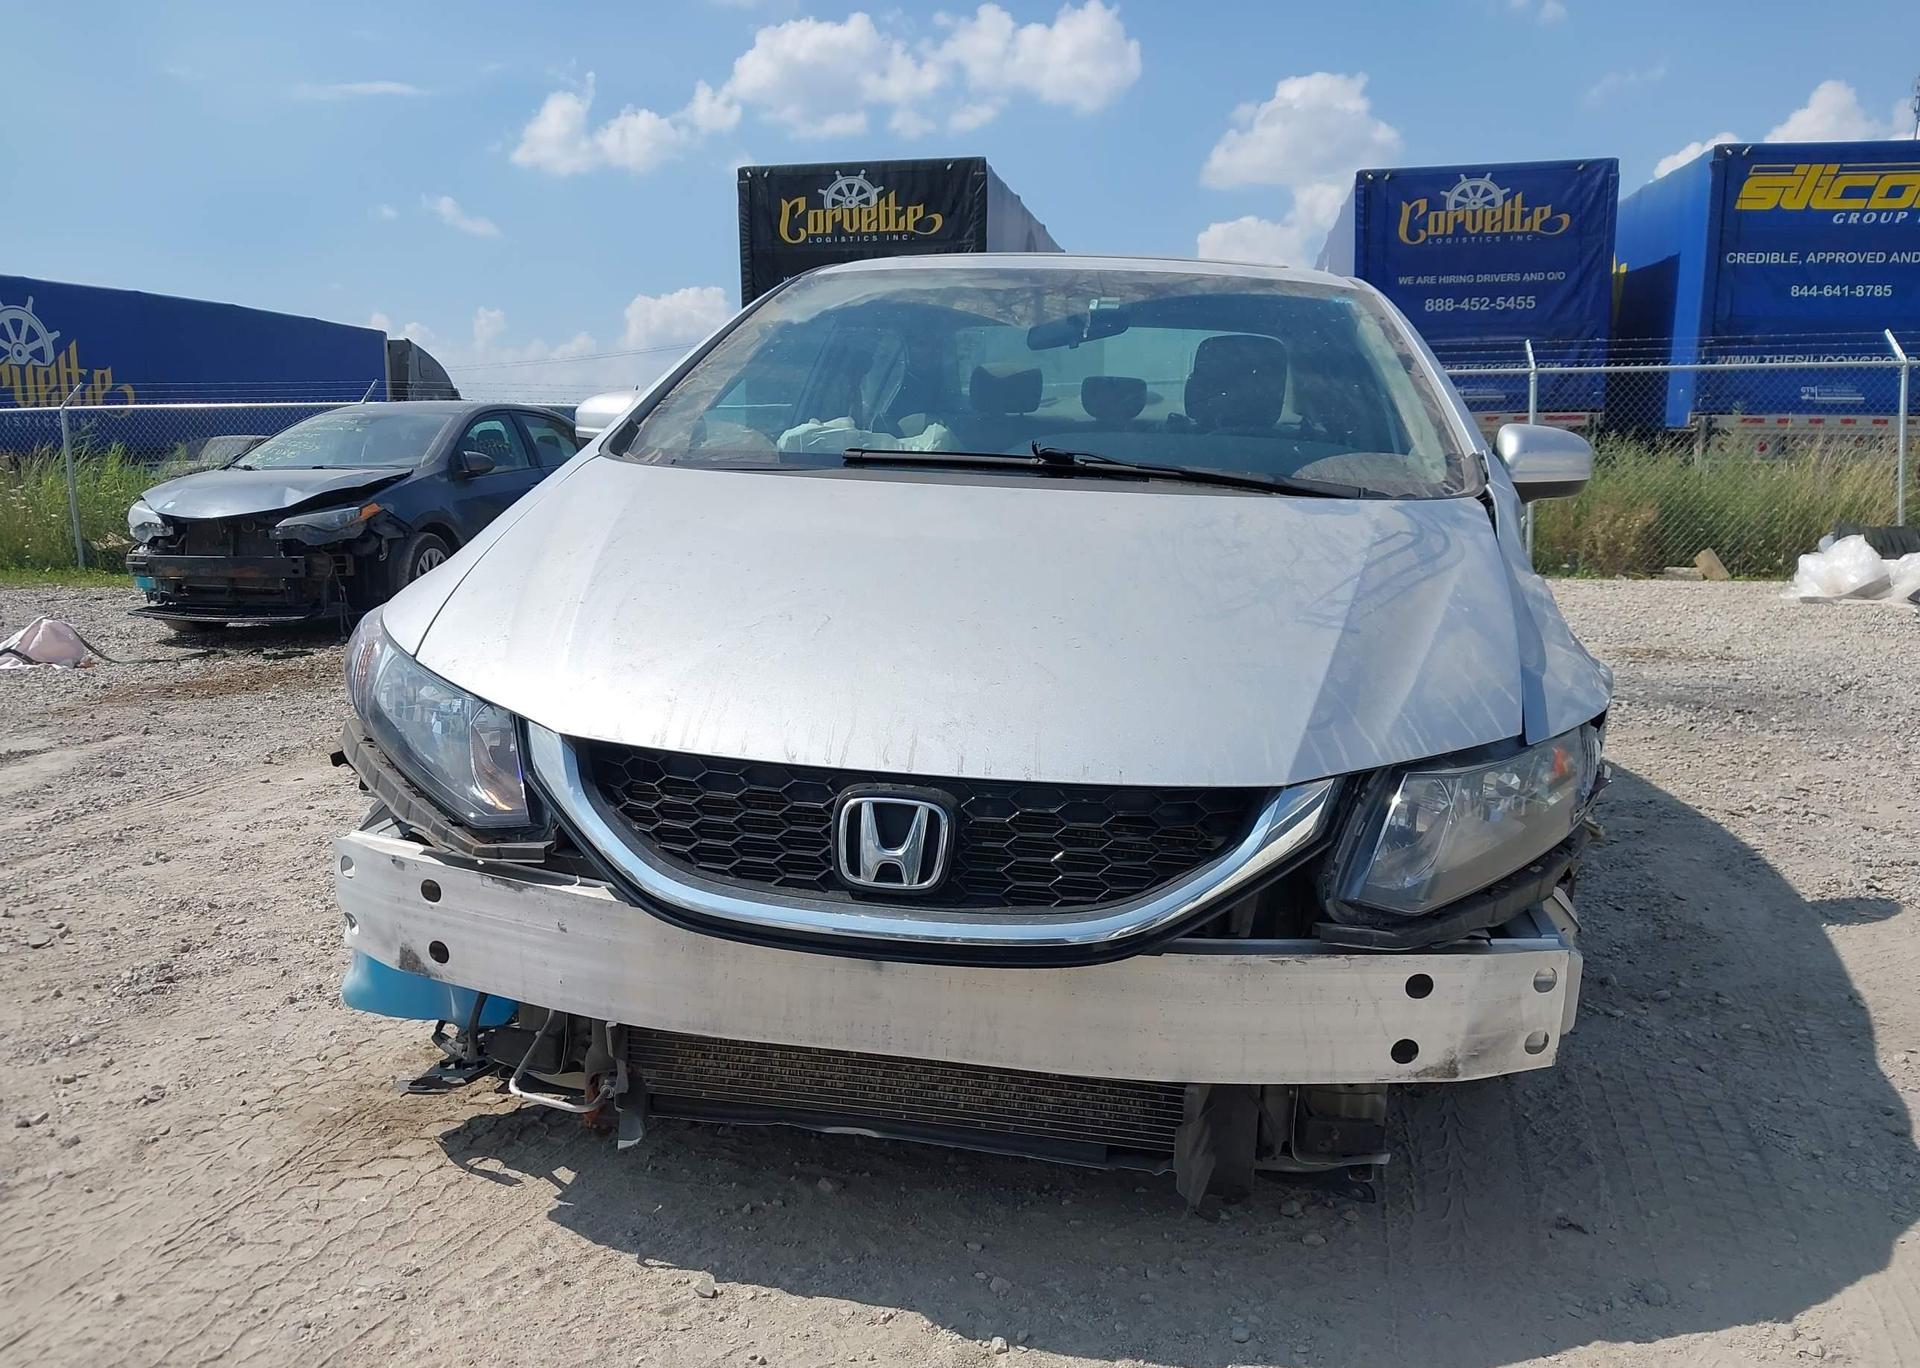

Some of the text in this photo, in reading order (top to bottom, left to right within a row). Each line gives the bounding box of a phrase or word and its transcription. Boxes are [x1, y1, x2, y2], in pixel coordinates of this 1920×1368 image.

[778, 190, 943, 244] Corvette
[1398, 192, 1570, 245] Corvette
[1832, 211, 1909, 224] GROUP
[808, 233, 916, 244] LOGISTICS INC.
[1428, 234, 1541, 245] LOGISTICS INC.
[1726, 251, 1920, 265] CREDIBLE, APPROVED AND
[1398, 276, 1415, 285] WE
[1416, 275, 1437, 284] ARE
[1438, 274, 1474, 284] HIRING
[1476, 273, 1521, 283] DRIVERS
[1522, 273, 1545, 282] AND
[1791, 285, 1893, 297] 844-641-8785
[1424, 296, 1536, 312] 888-452-5455
